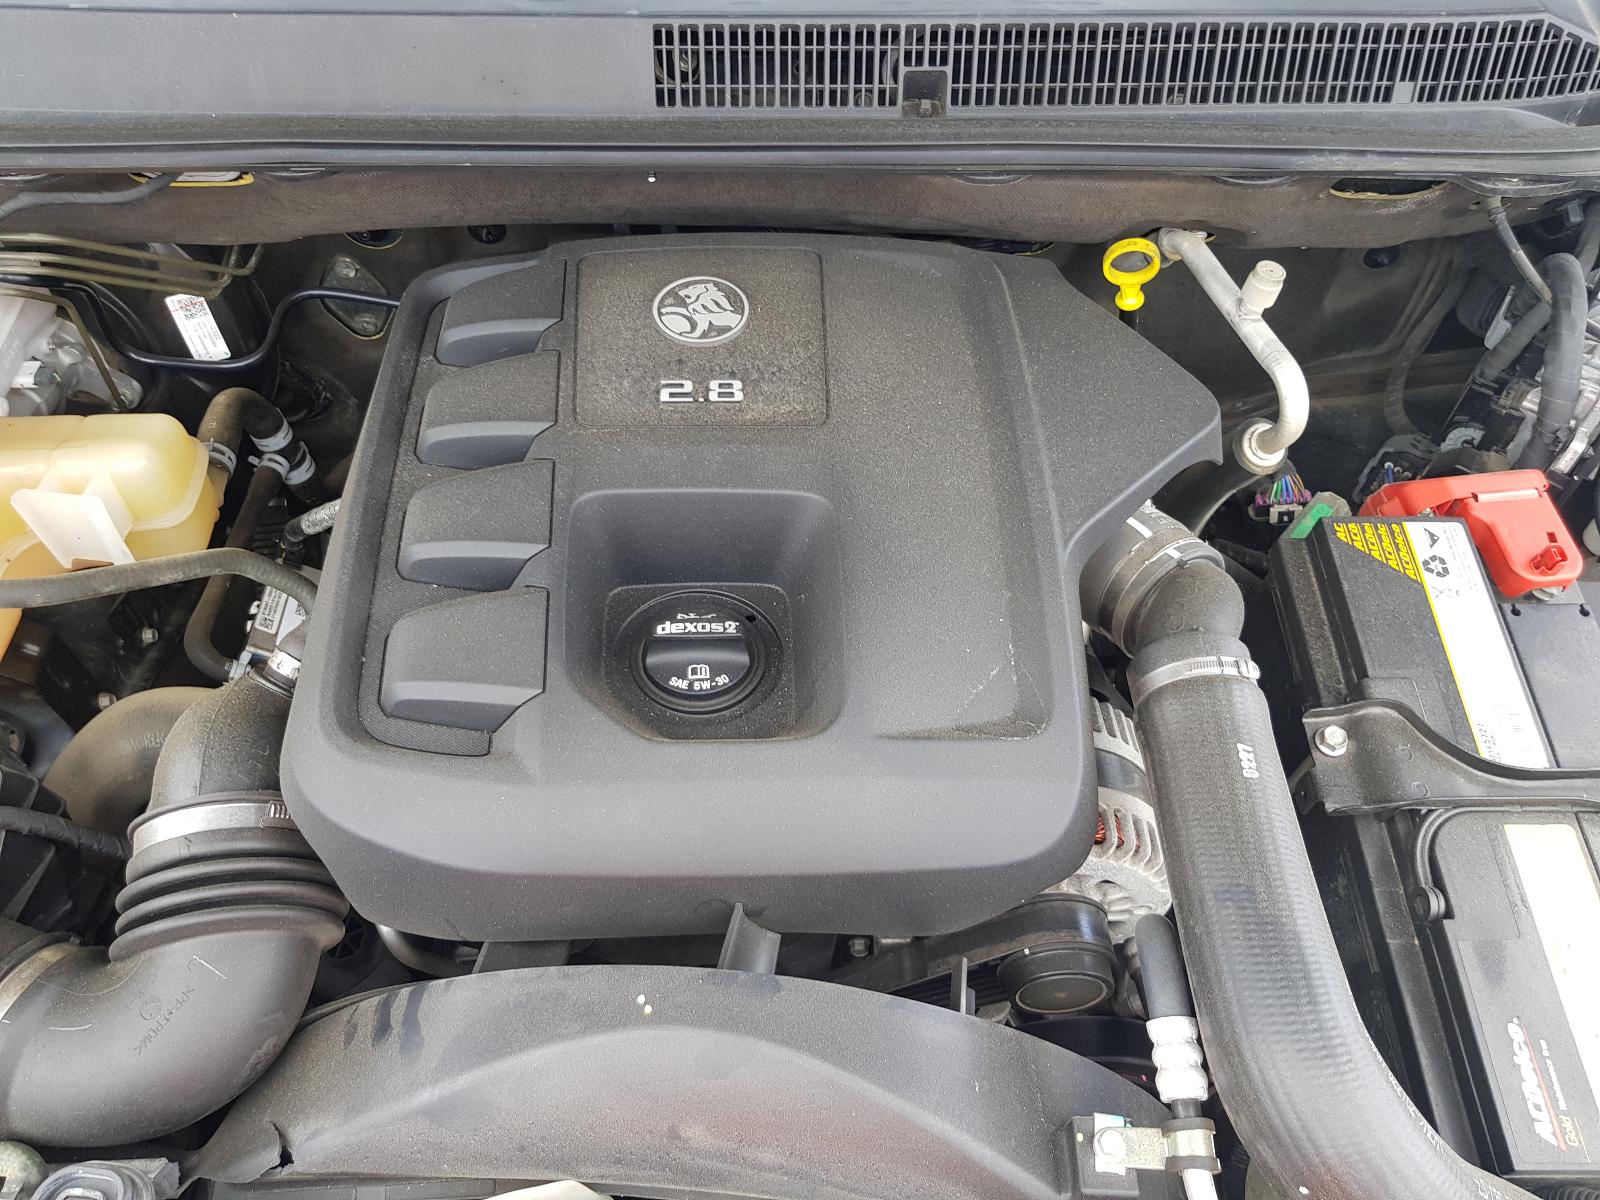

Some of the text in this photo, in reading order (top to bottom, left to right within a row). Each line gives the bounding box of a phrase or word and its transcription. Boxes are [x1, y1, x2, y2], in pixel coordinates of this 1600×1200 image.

[659, 380, 744, 402] 2.8
[1333, 522, 1348, 543] AC
[1391, 523, 1418, 581] ACDelco
[669, 674, 730, 690] SAE 5W-30
[1506, 1021, 1559, 1148] ACDelco
[1558, 1113, 1579, 1147] Gold
